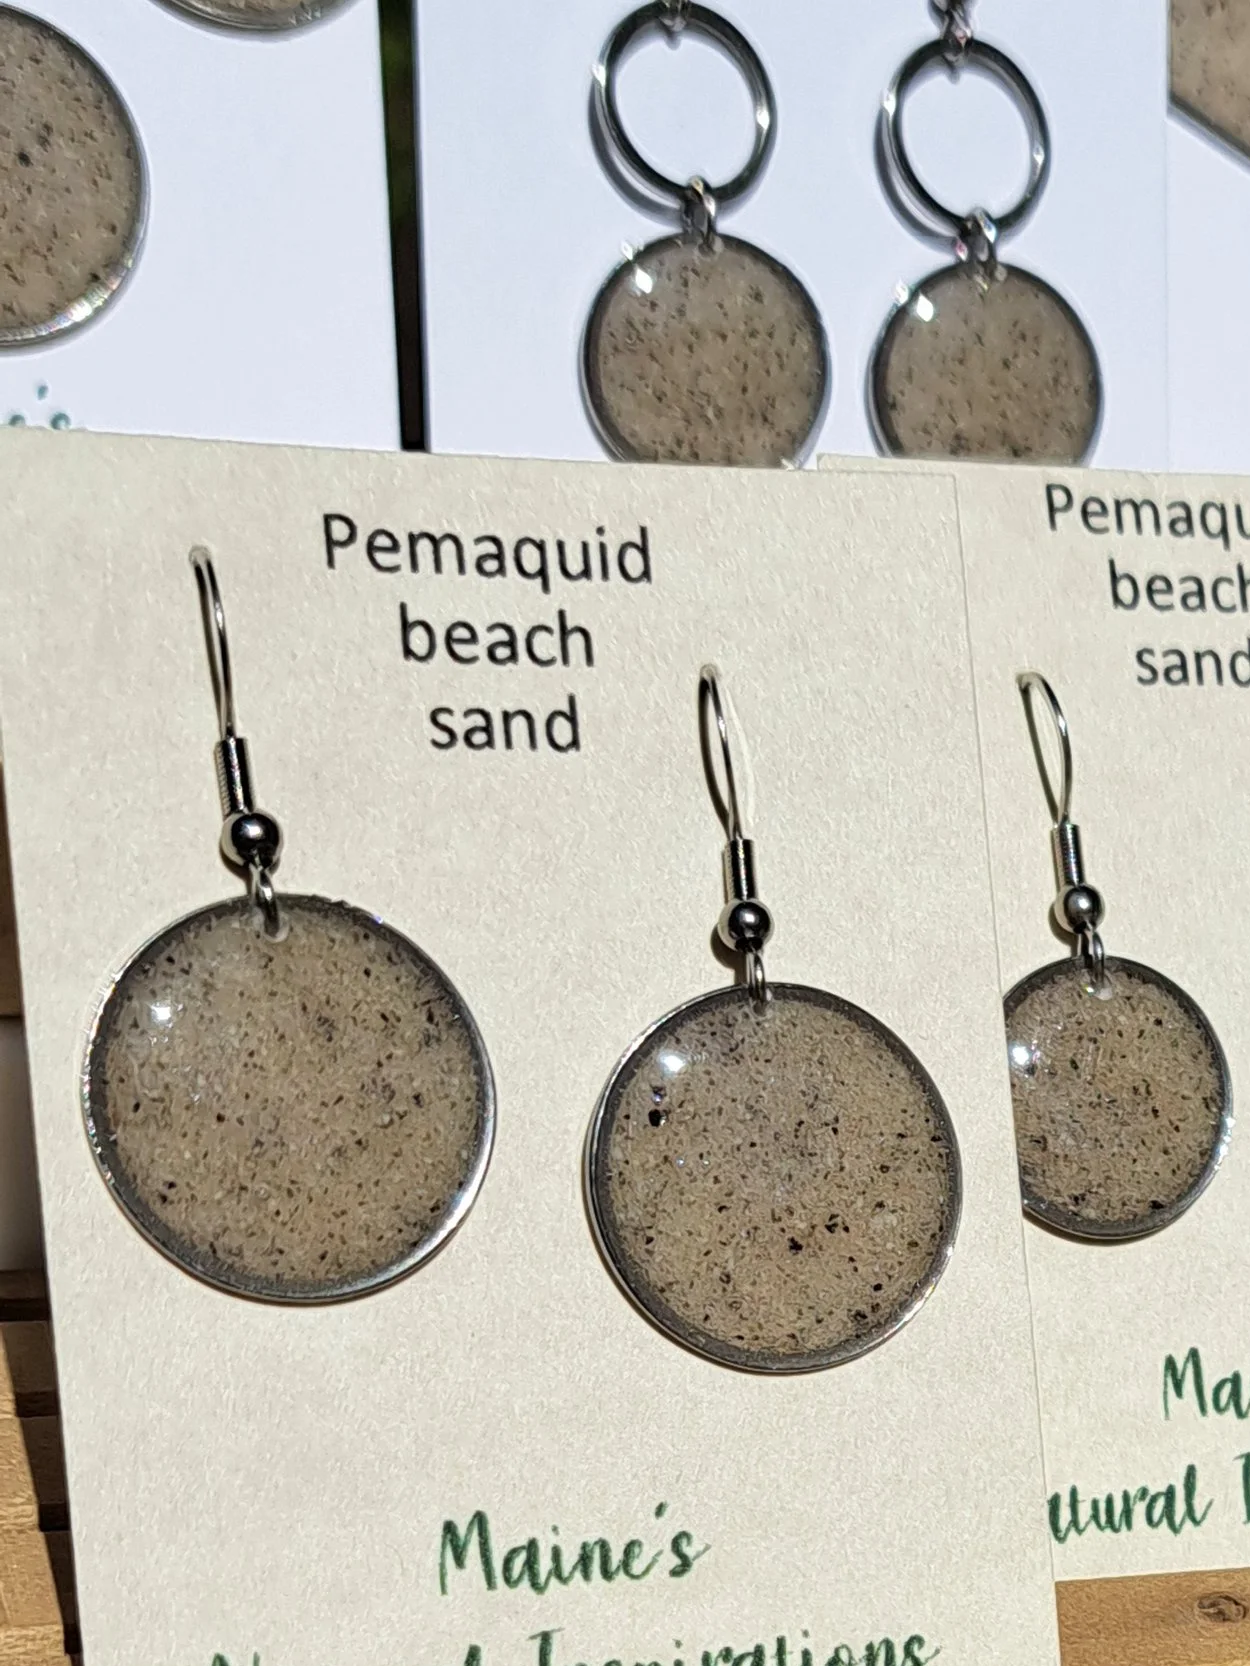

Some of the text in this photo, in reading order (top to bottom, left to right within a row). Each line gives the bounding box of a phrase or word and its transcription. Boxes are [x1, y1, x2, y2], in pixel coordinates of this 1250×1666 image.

[320, 512, 655, 594] Pemaquid
[398, 601, 597, 669] beach
[427, 695, 583, 754] sand
[438, 1501, 712, 1596] Maine's
